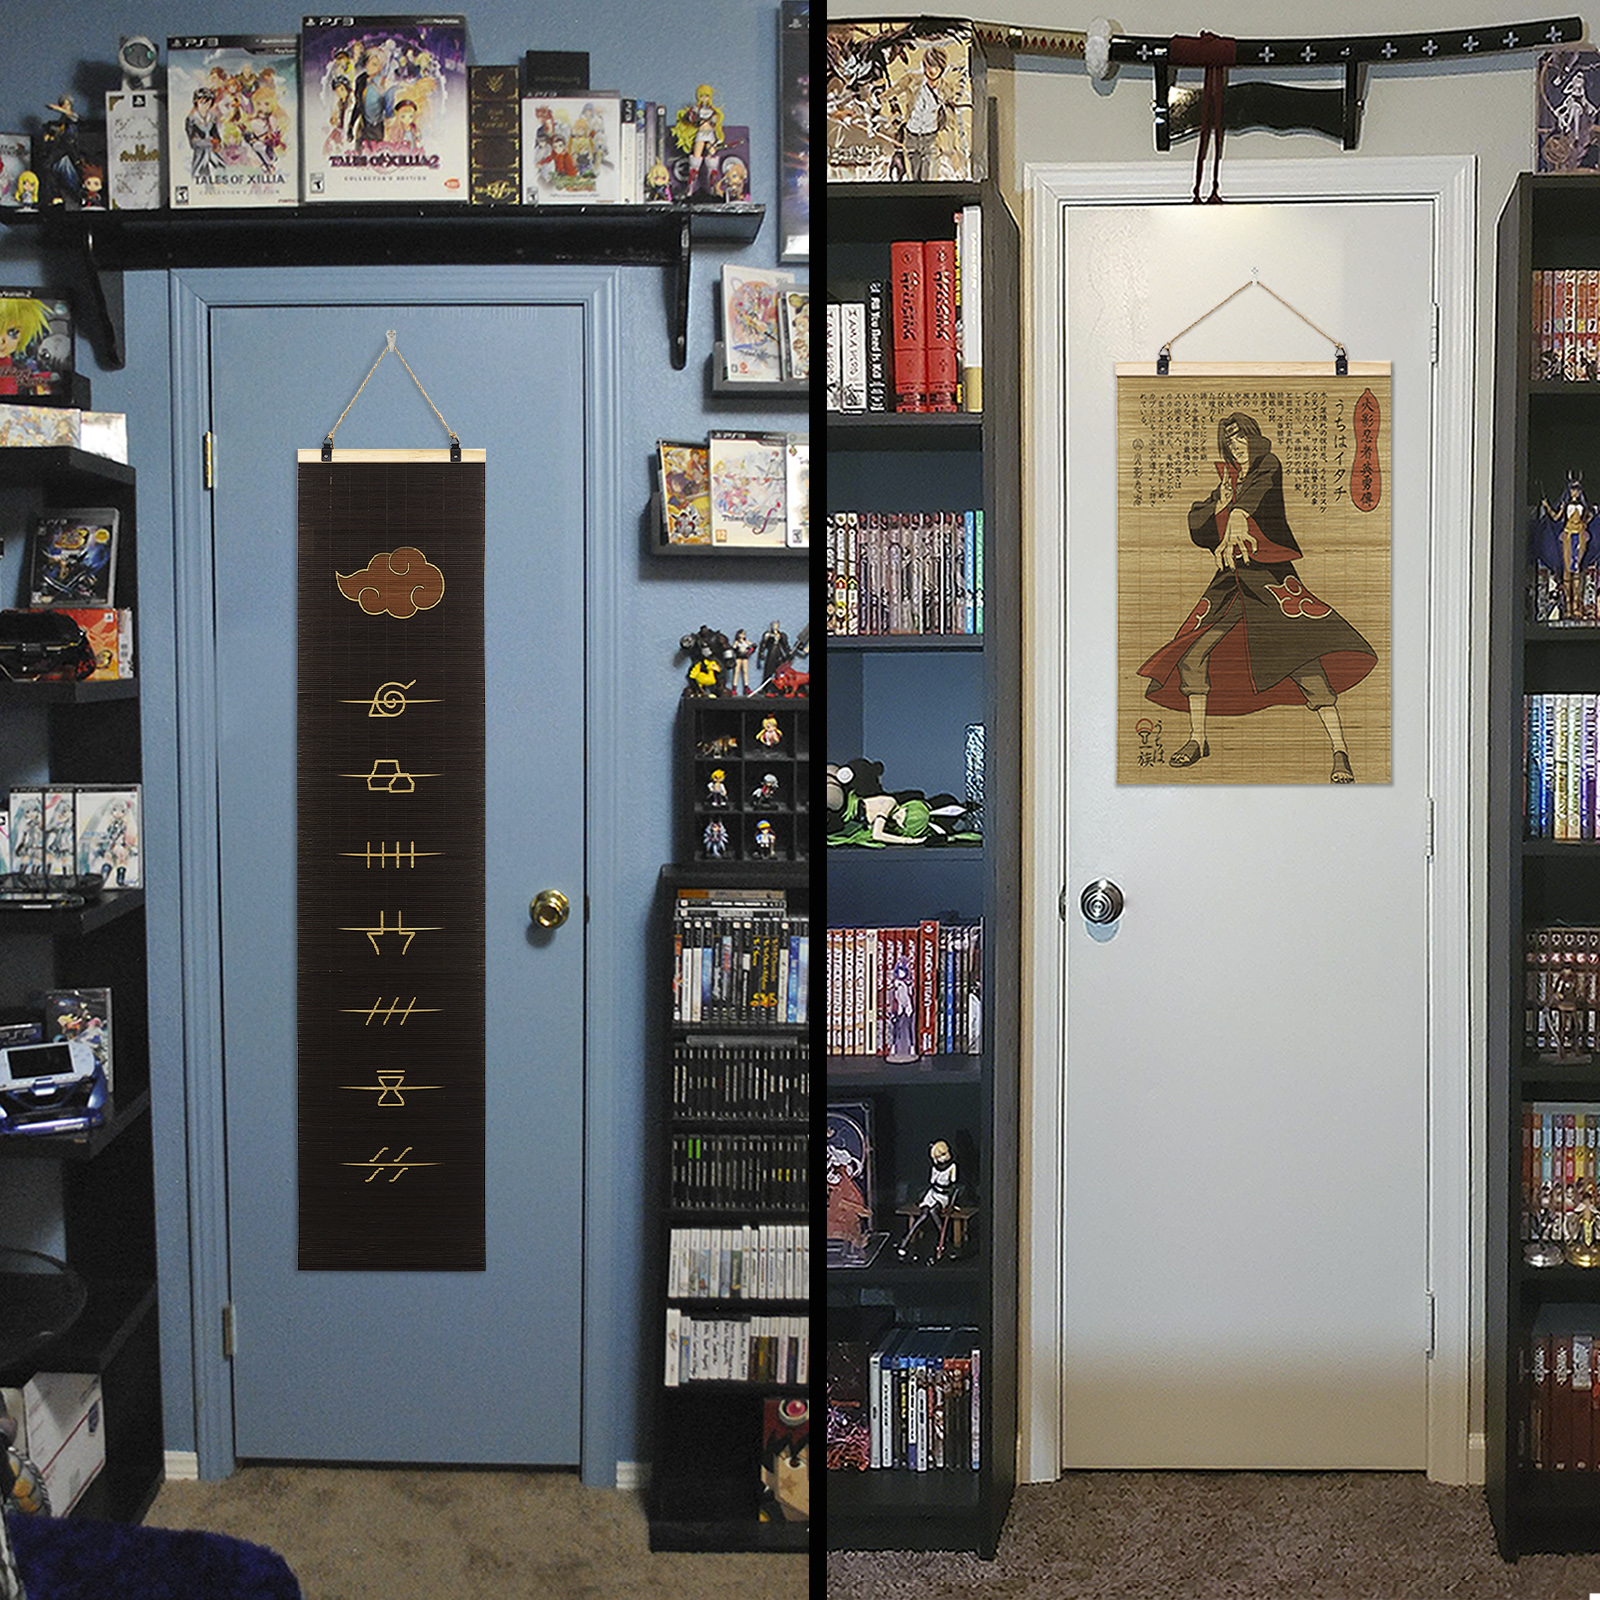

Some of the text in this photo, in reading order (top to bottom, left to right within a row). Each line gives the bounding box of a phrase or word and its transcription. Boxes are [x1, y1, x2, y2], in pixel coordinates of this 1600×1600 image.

[319, 17, 355, 27] PS3
[184, 38, 219, 48] PS3
[328, 154, 368, 168] TALES
[195, 173, 285, 185] TALES OF XILLIA
[1333, 399, 1348, 502] うちはイタチ
